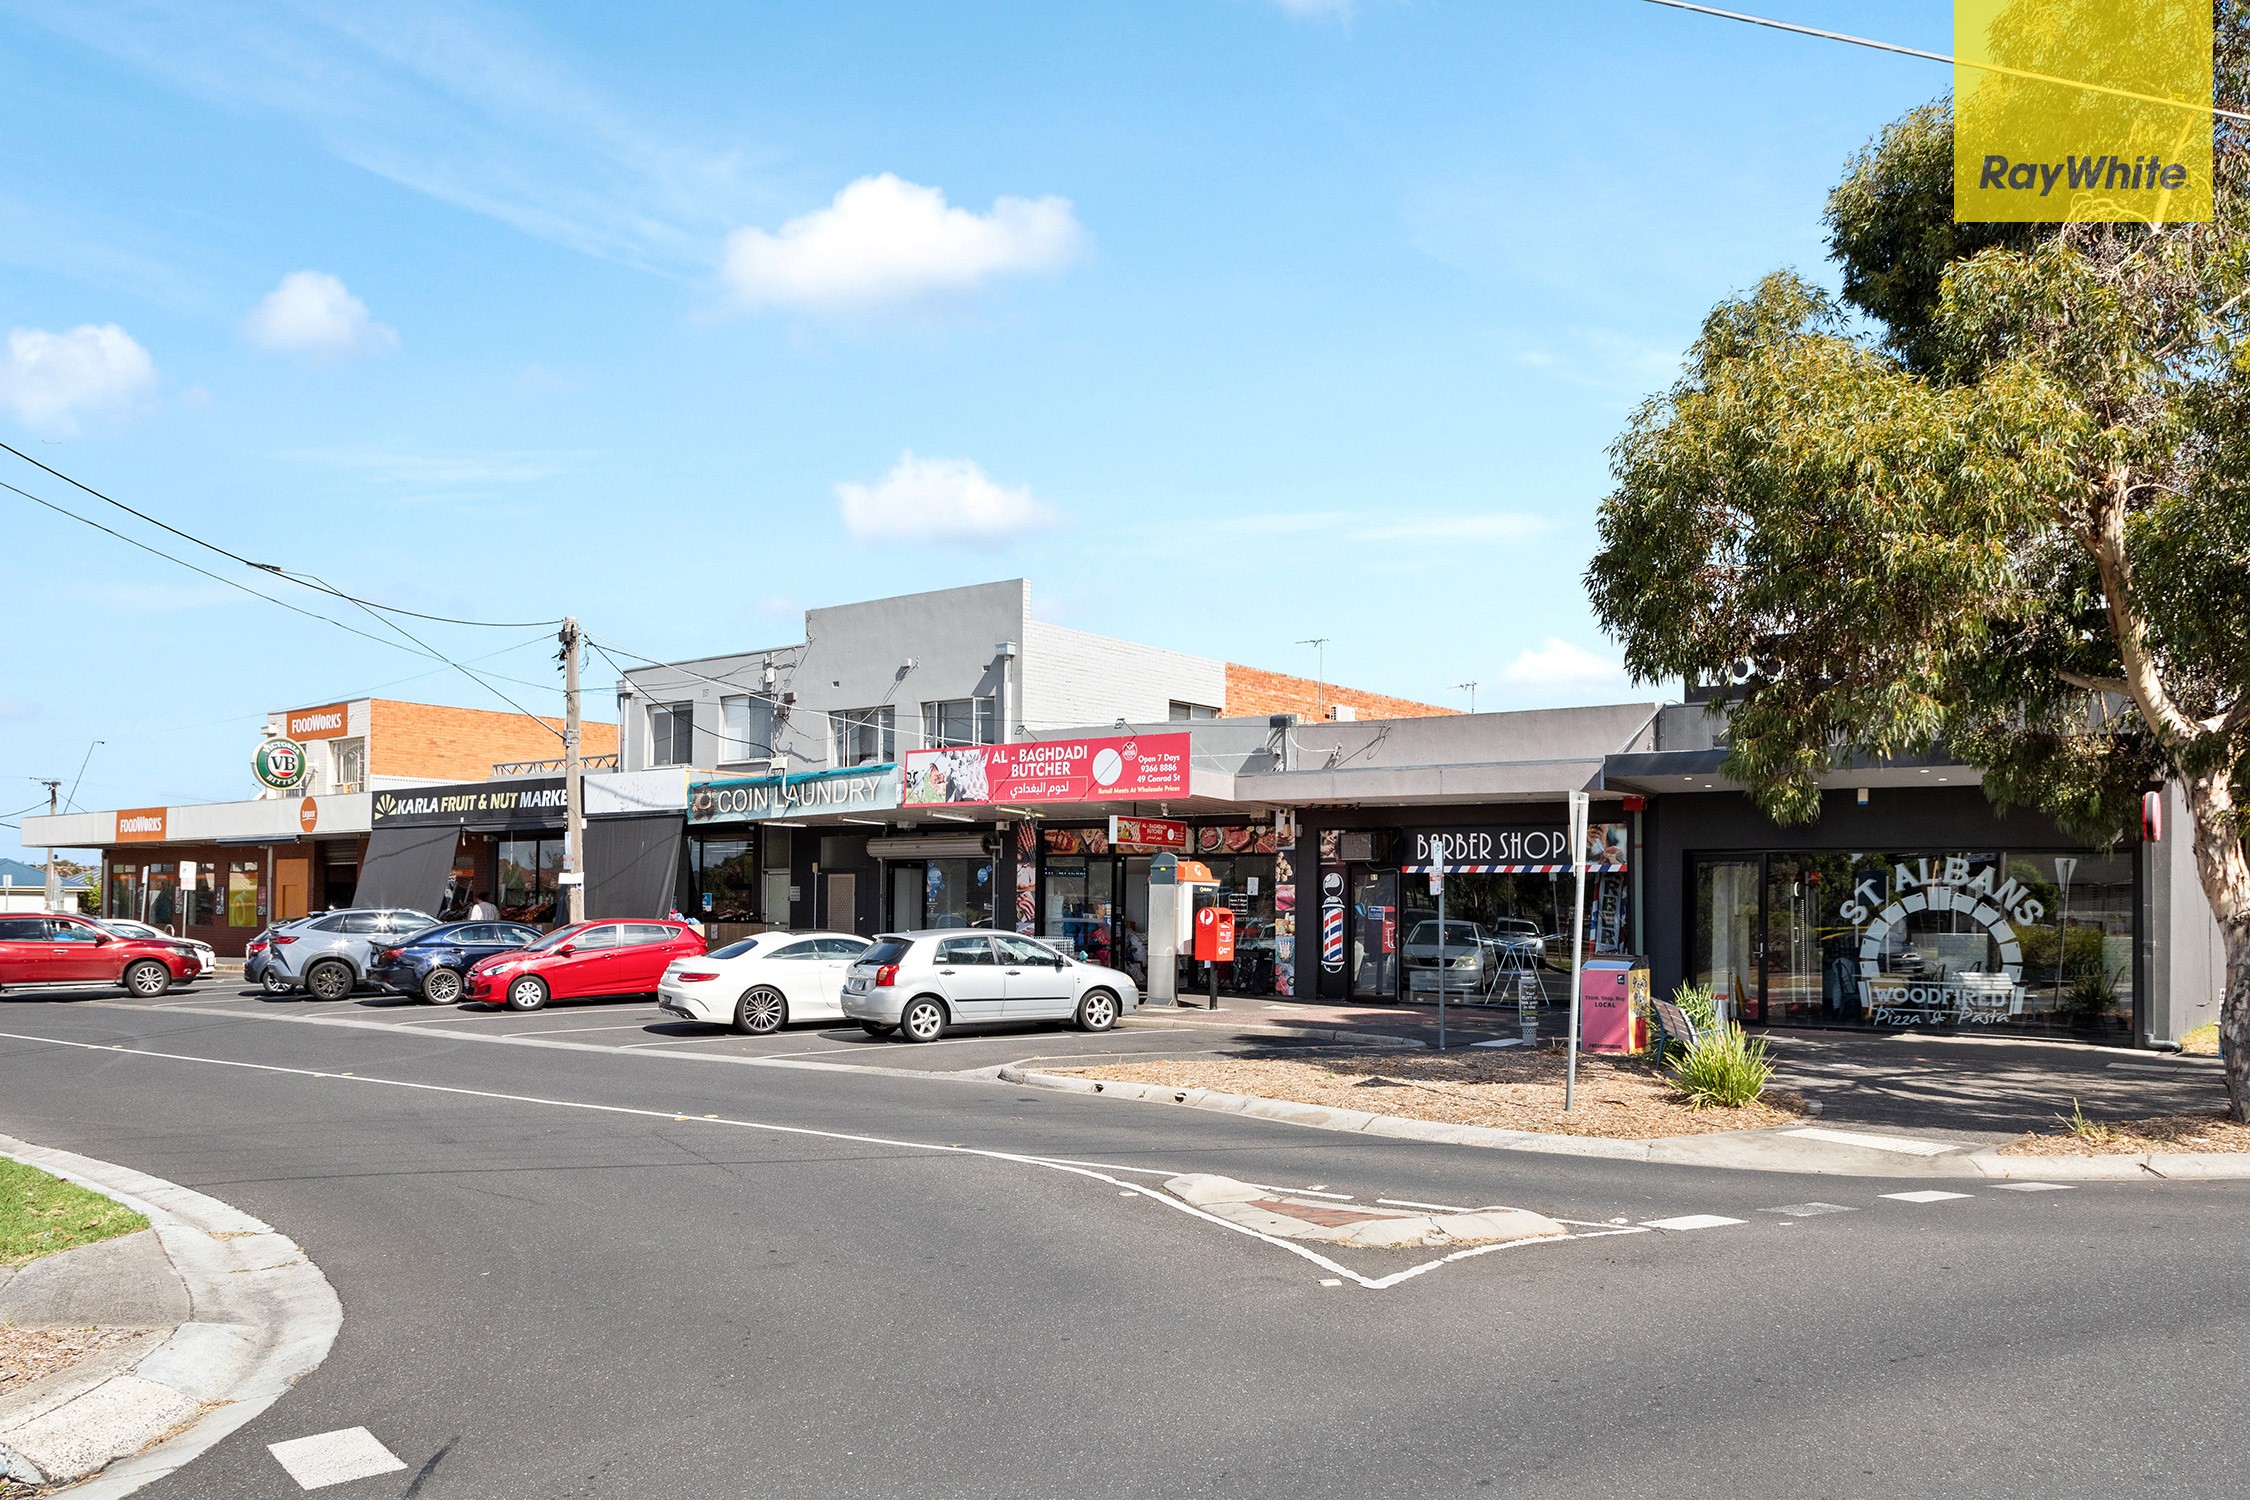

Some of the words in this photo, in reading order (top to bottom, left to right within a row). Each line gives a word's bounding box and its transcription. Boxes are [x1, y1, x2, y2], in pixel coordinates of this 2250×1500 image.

[262, 741, 300, 755] VICTORIA
[991, 750, 1009, 764] AL
[1019, 745, 1088, 762] BAGHDADI
[270, 756, 295, 771] VB
[1137, 755, 1156, 764] Open
[1157, 754, 1162, 762] 7
[1163, 754, 1180, 763] Days
[1011, 761, 1071, 777] BUTCHER
[1140, 764, 1158, 773] 9366
[1159, 763, 1177, 772] 8886
[266, 774, 299, 785] BITTER
[1136, 775, 1145, 784] 49
[717, 786, 769, 813] COIN
[774, 776, 883, 809] LAUNDRY
[1097, 787, 1113, 795] Retail
[397, 797, 439, 815] KARLA
[440, 795, 477, 812] FRUIT
[478, 793, 488, 809] &
[489, 792, 518, 809] NUT
[519, 789, 568, 808] MARKE
[1499, 831, 1566, 860] SHOP
[1840, 879, 1884, 925] ST
[1895, 856, 2044, 926] ALBANS
[1873, 987, 2007, 1007] WOODFIRED
[1873, 1008, 1922, 1026] Pizza
[1957, 1006, 2010, 1025] Pasta
